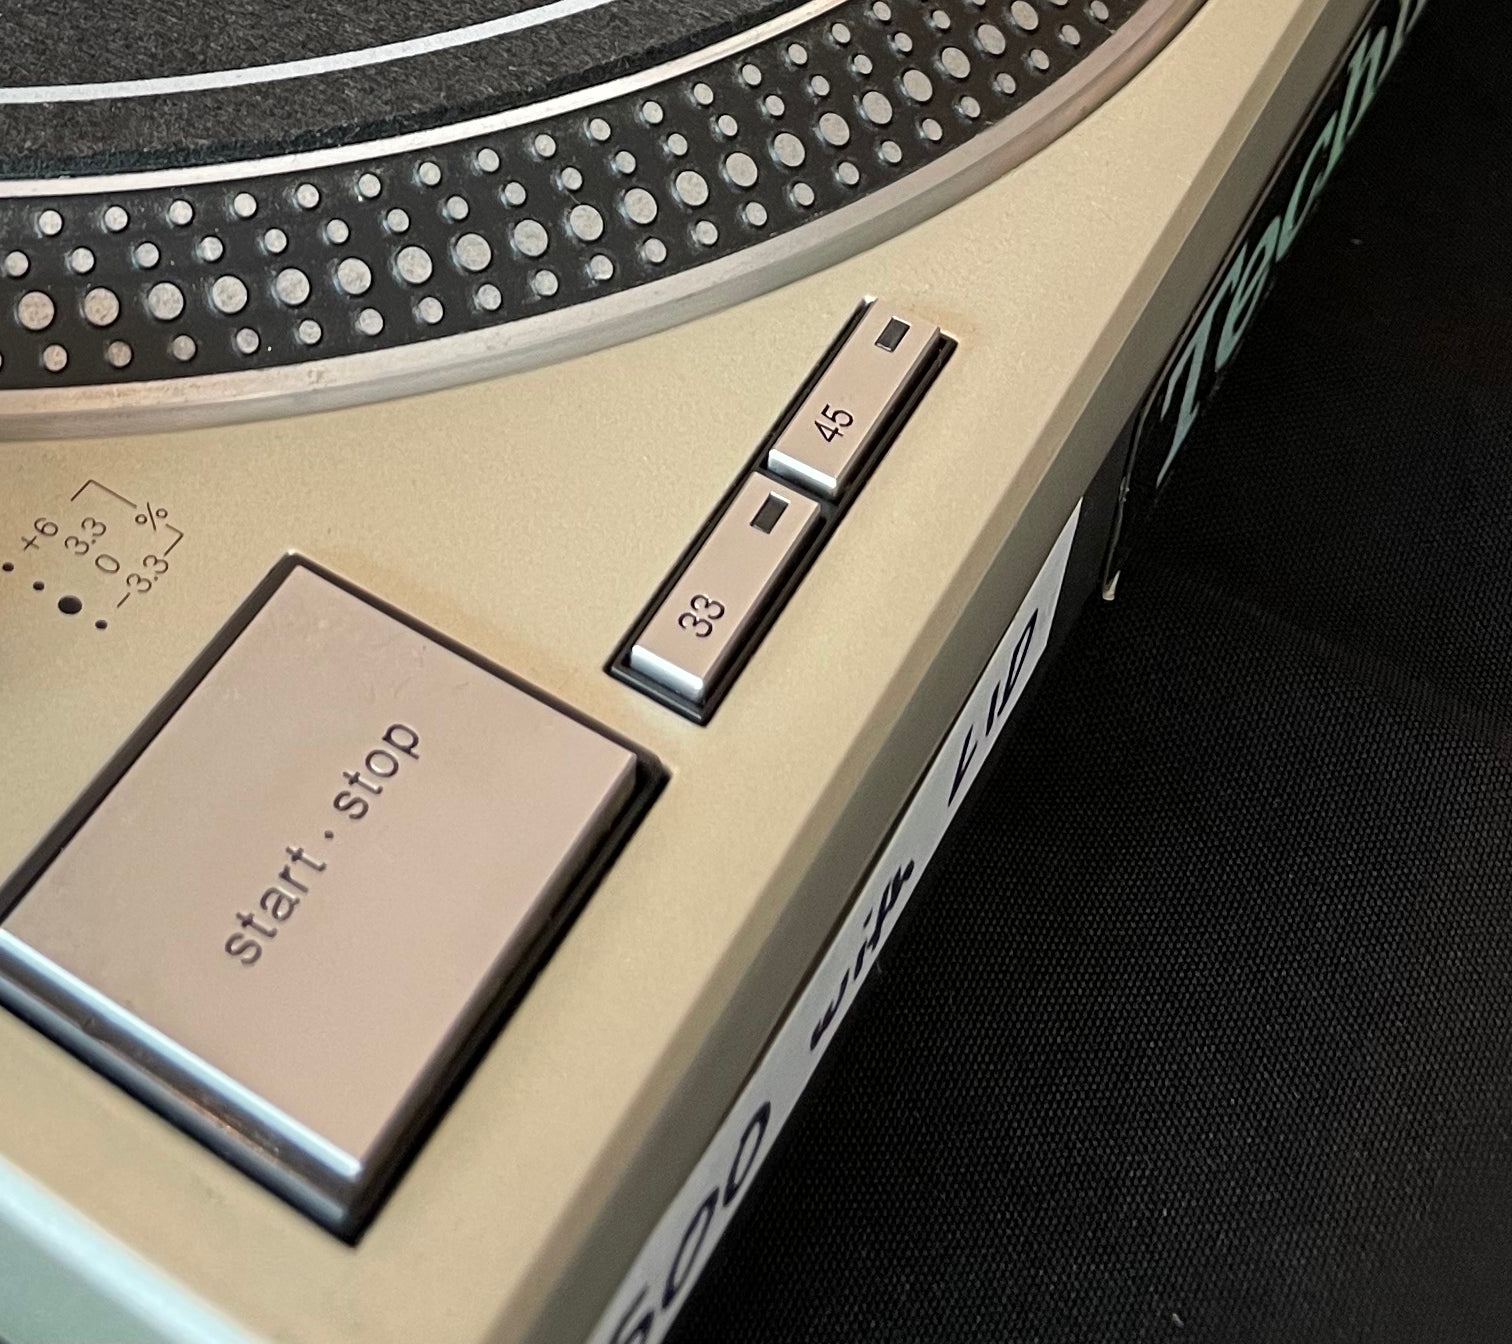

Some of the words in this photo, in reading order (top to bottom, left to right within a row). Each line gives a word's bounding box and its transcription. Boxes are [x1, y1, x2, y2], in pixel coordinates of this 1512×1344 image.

[814, 402, 855, 445] 45
[20, 516, 59, 552] +6
[64, 516, 107, 556] 3.3
[134, 501, 169, 533] %
[94, 553, 121, 585] 0
[677, 593, 727, 639] 33
[810, 859, 916, 1051] with
[947, 607, 1038, 808] LID
